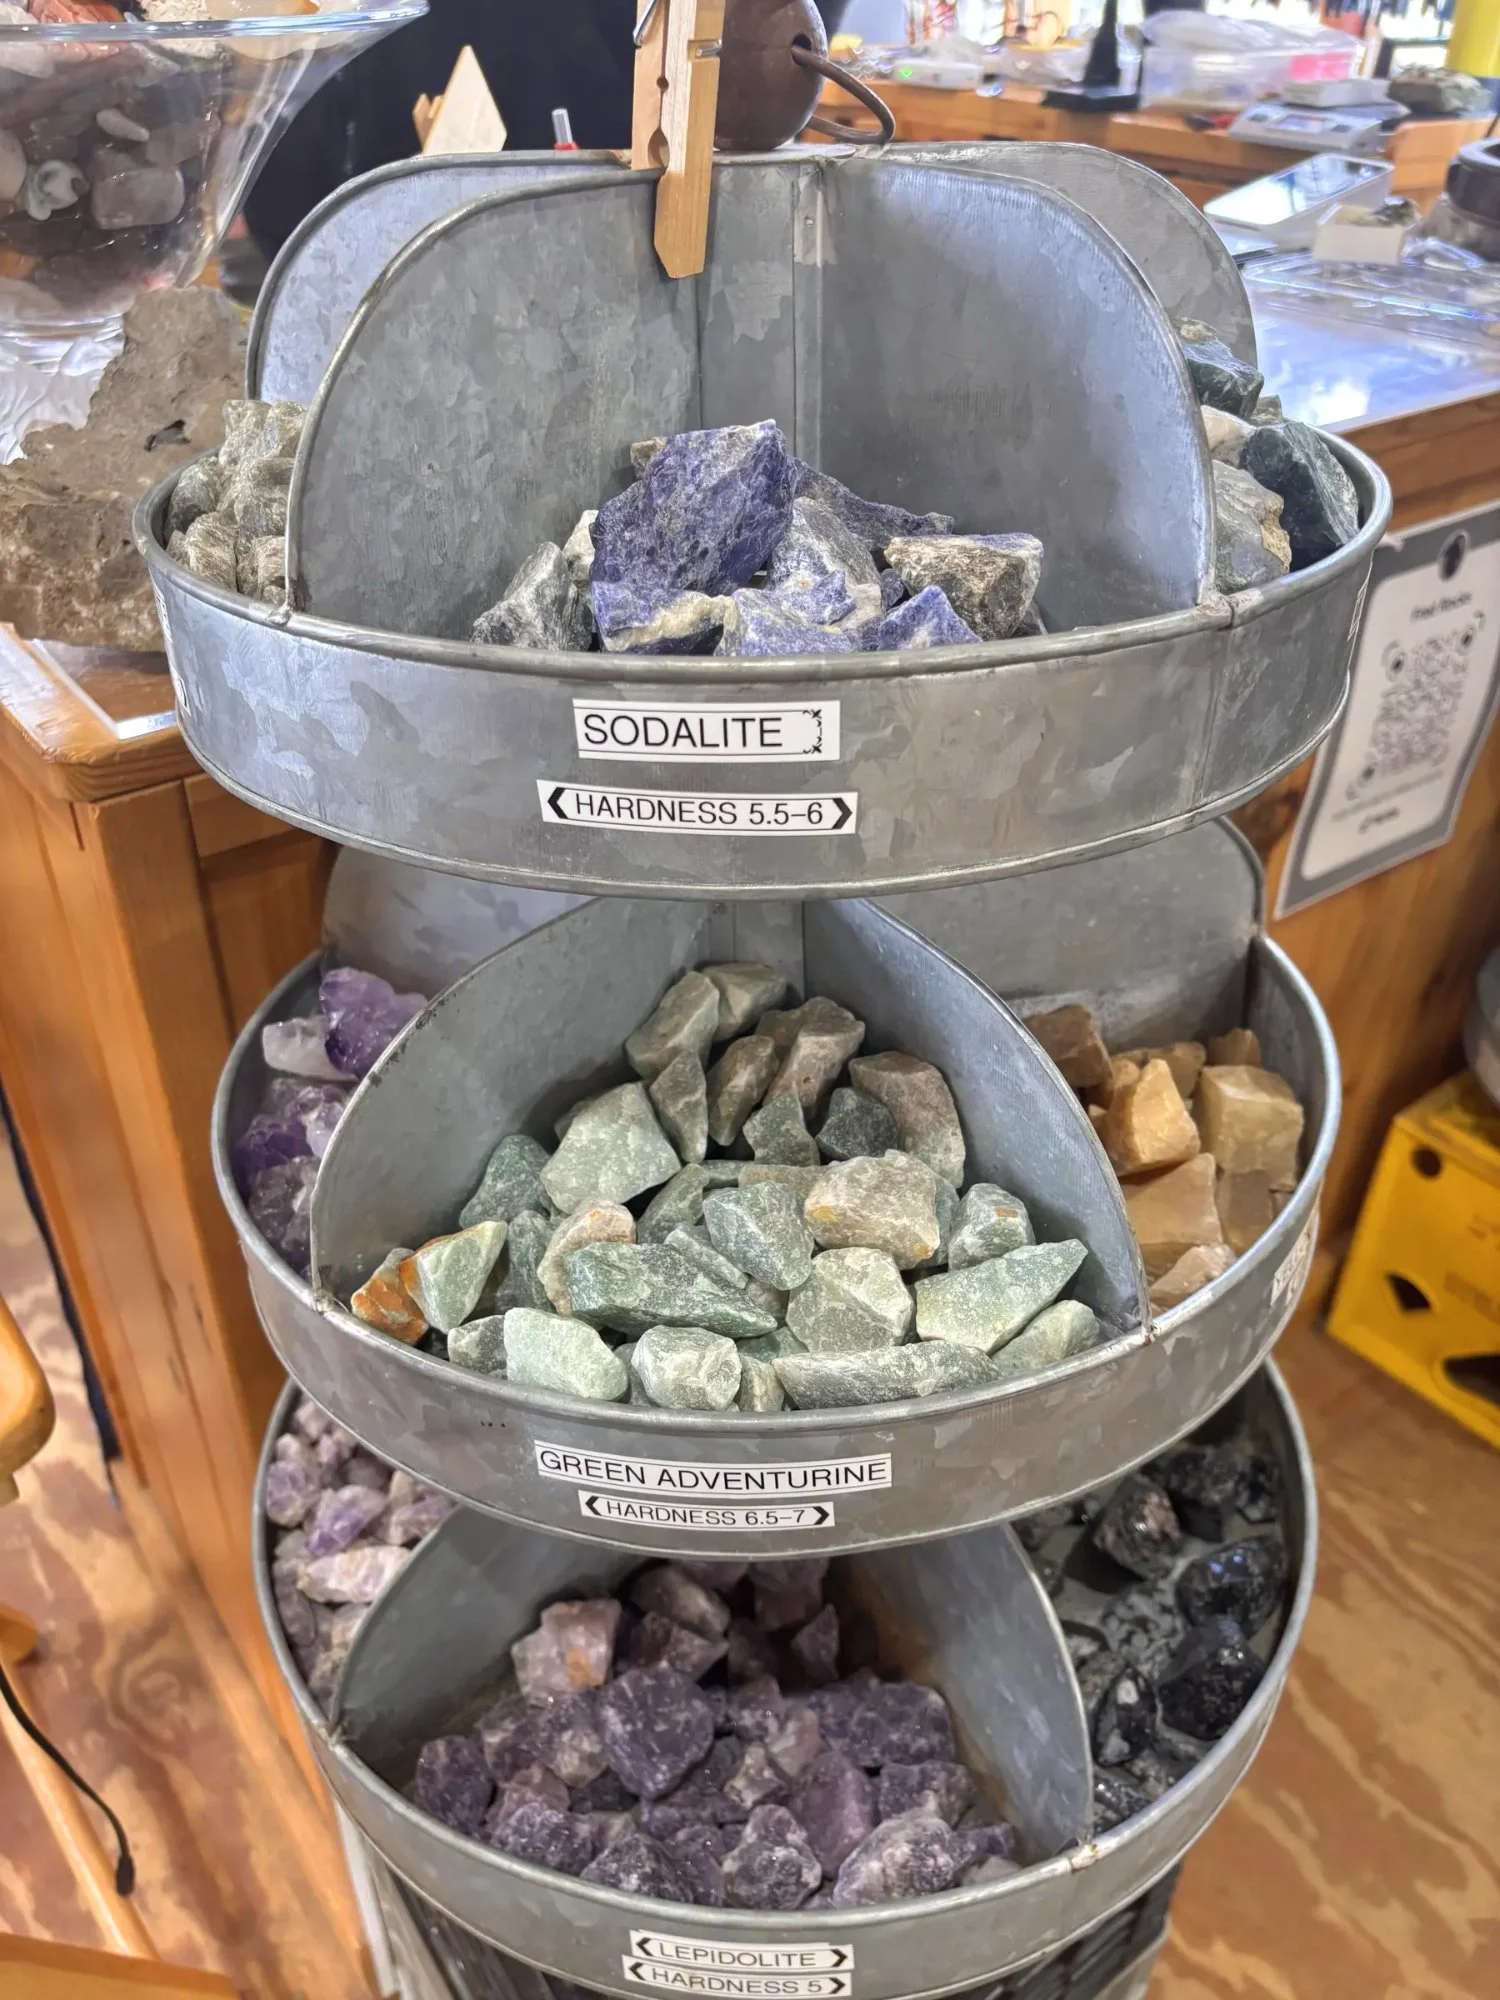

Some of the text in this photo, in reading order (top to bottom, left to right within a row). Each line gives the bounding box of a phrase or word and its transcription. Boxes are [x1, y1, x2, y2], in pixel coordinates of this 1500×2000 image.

[584, 713, 783, 747] SODALITE
[576, 793, 738, 824] HARDNESS
[540, 1451, 886, 1490] GREEN ADVENTURINE
[607, 1500, 736, 1526] HARDNESS
[660, 1943, 815, 1966] LEPIDOLITE
[652, 1967, 822, 1993] HARDNESS 5
